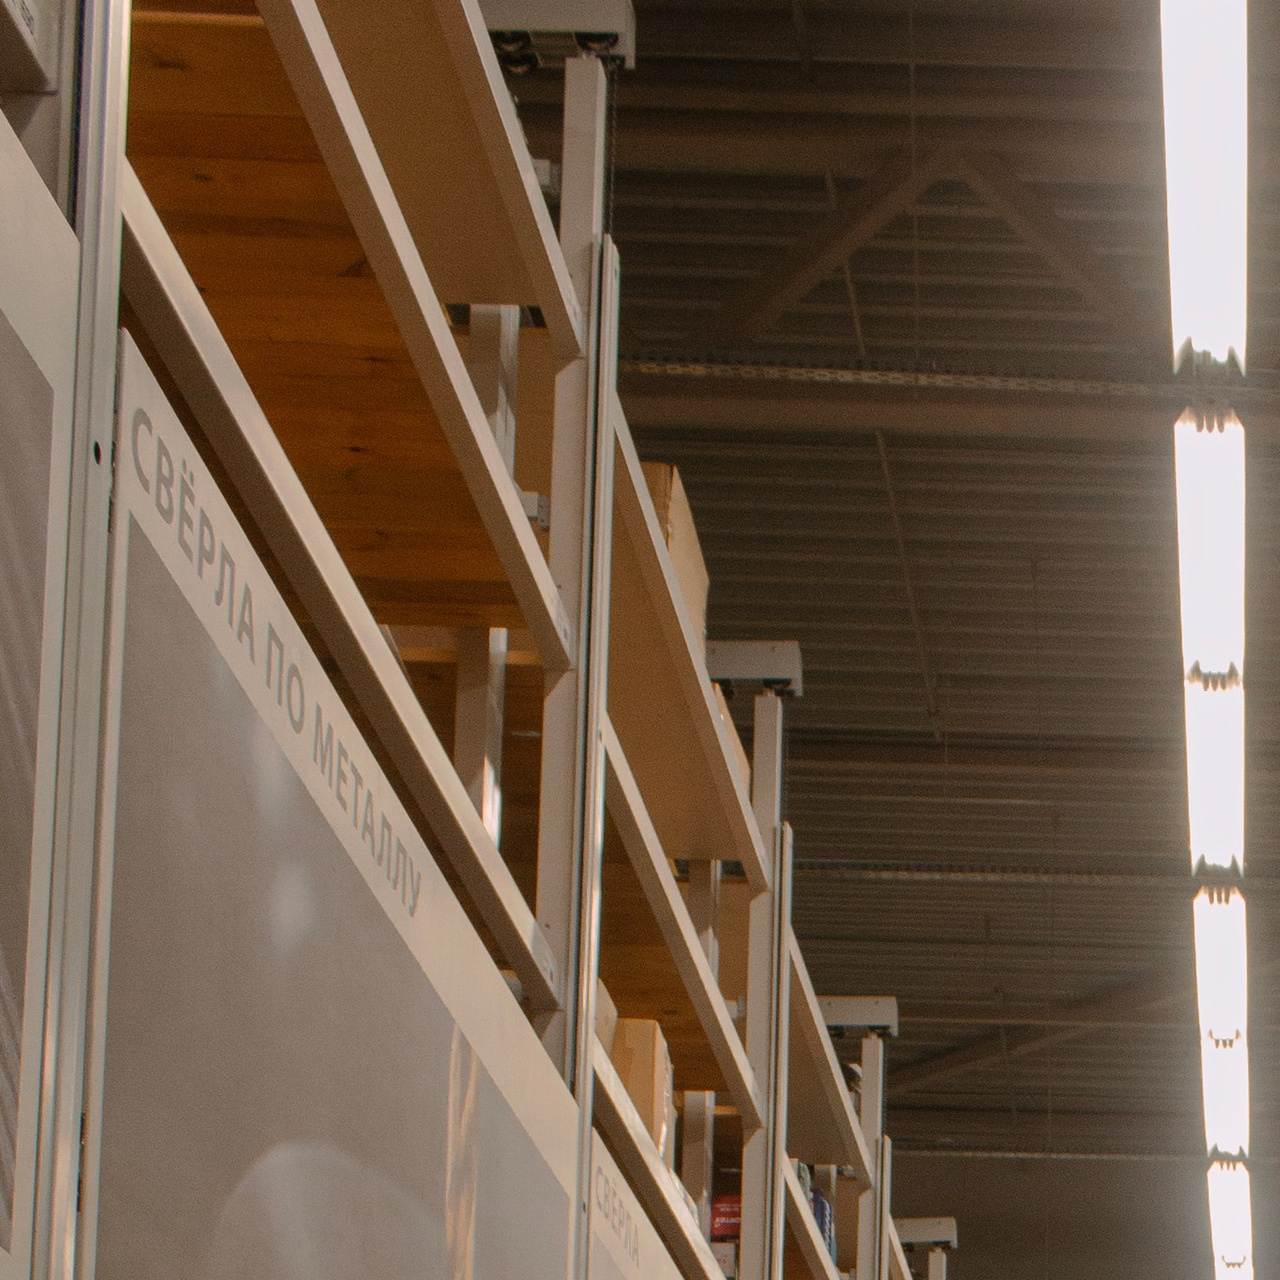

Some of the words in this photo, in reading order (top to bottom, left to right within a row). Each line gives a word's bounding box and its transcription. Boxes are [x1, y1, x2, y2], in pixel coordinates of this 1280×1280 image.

[130, 407, 258, 667] СВЁРЛА
[265, 638, 306, 735] ПО
[312, 702, 424, 918] МЕТАЛЛУ
